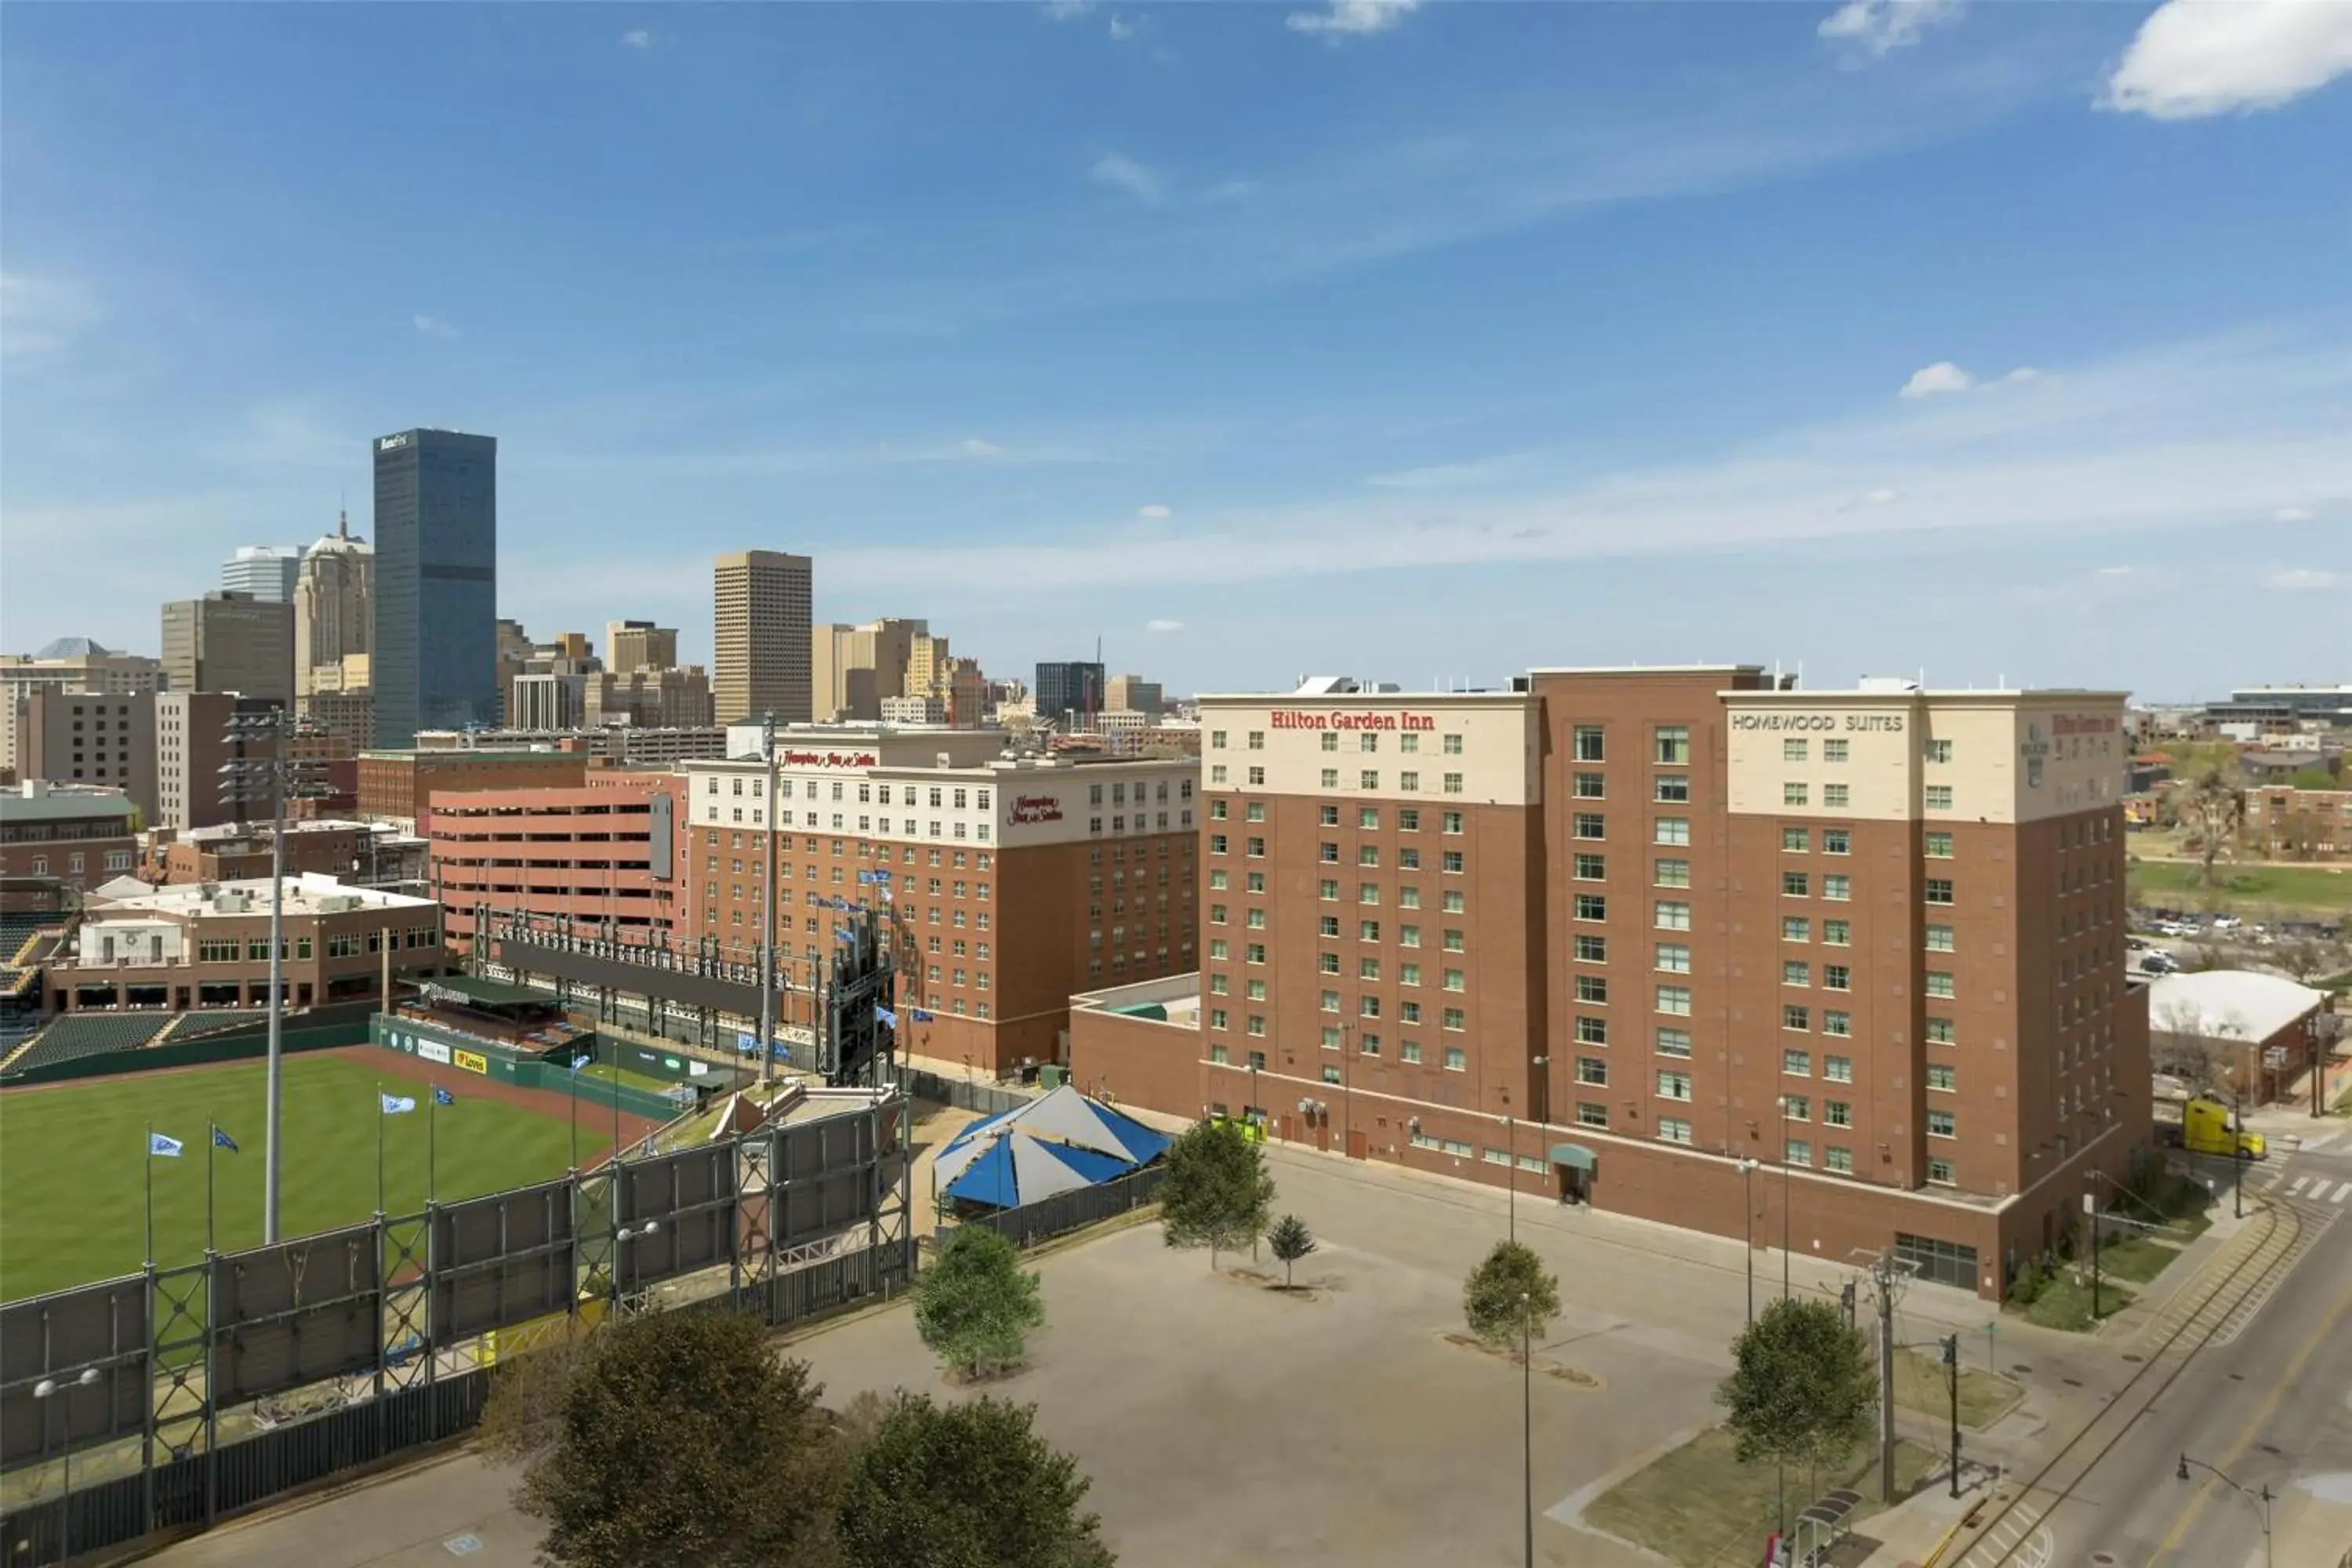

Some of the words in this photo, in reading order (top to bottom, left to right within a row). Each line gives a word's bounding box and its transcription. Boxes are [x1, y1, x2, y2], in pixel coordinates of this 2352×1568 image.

[1271, 711, 1327, 729] Hilton
[1330, 711, 1396, 731] Garden
[1401, 711, 1435, 731] Inn
[1733, 715, 1835, 731] HOMEWOOD
[1846, 716, 1904, 731] SUITES
[779, 750, 821, 767] Hampton
[822, 753, 842, 768] Inn
[1011, 794, 1059, 811] Hampton
